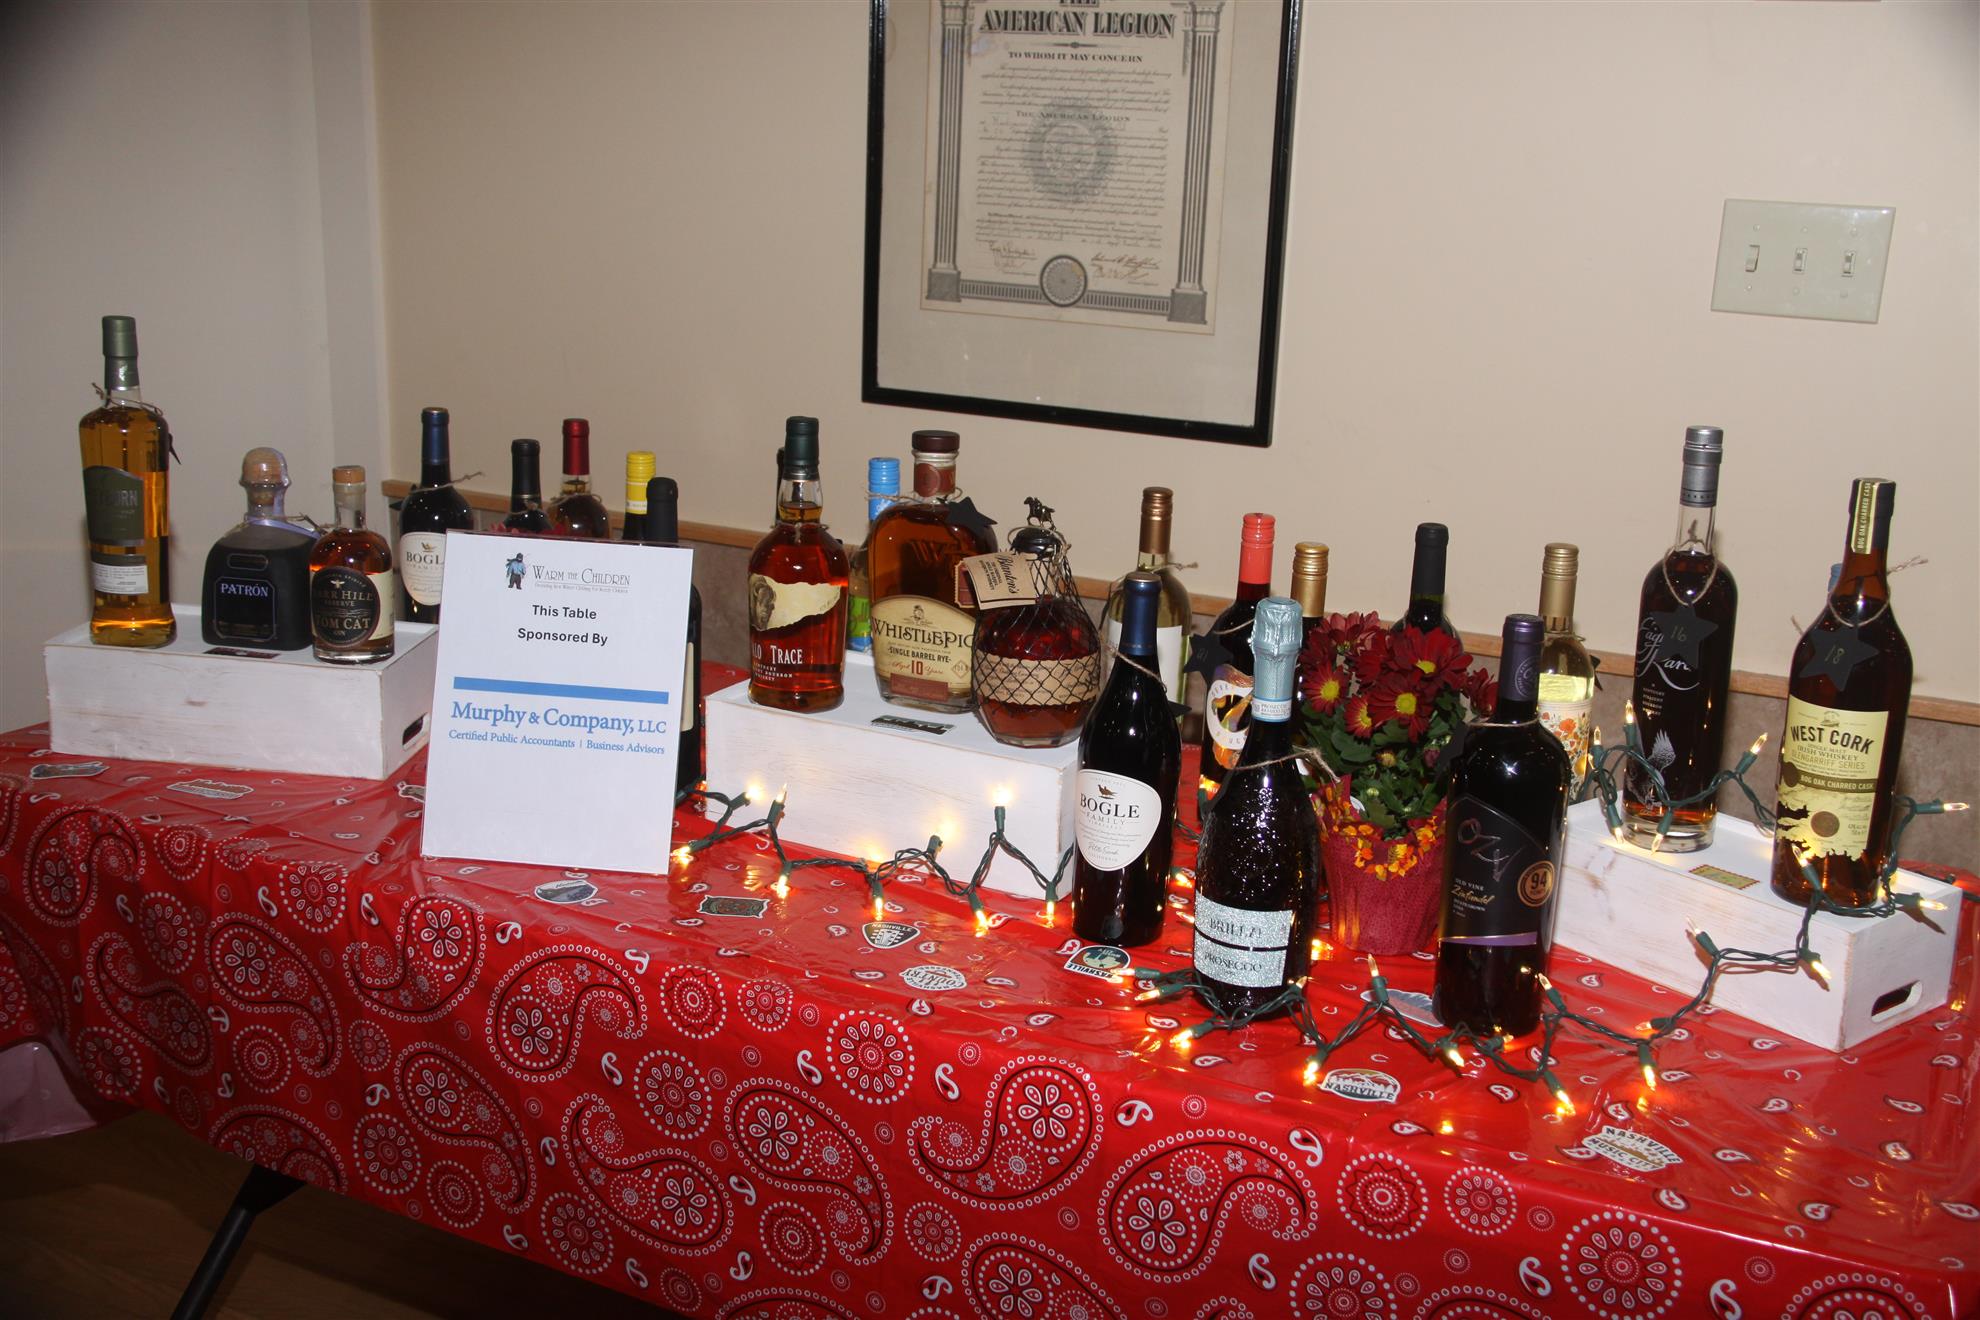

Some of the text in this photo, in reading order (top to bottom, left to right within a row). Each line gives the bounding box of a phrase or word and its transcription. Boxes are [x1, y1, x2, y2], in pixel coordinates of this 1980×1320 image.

[980, 9, 1177, 38] AMERICAN LEGION
[1008, 51, 1143, 63] TO WHOM IT MAY CONCERN
[406, 551, 446, 565] BOGL
[341, 590, 374, 601] HILL
[532, 604, 597, 620] This Table
[343, 618, 371, 630] CAT
[517, 627, 608, 647] Sponsored By
[1670, 625, 1688, 642] 16
[770, 645, 803, 665] TRACE
[911, 650, 936, 662] BARREL
[1824, 643, 1846, 665] 18
[911, 660, 924, 676] 10
[451, 701, 667, 736] Murphy & Company, LLC
[449, 729, 665, 754] Certified Public Accountants Business Advisors
[1790, 725, 1875, 755] WEST CORK
[1817, 751, 1858, 761] WHISKEY
[1838, 760, 1866, 769] SERIES
[1800, 775, 1874, 790] BOG OAK CHARRED CASK
[1080, 793, 1141, 819] BOGLE
[1086, 812, 1126, 825] FAMILY
[1468, 882, 1485, 891] VINE
[1531, 871, 1548, 889] 94
[871, 922, 913, 932] NASHVILLE
[1066, 962, 1114, 979] NASHVILLE
[1204, 951, 1262, 973] PROSECCO
[901, 968, 965, 989] COUNTRY
[1325, 1082, 1395, 1100] NASHVILLE
[1606, 1127, 1682, 1163] NASHVILLE
[1588, 1138, 1660, 1170] MUSIC CITY
